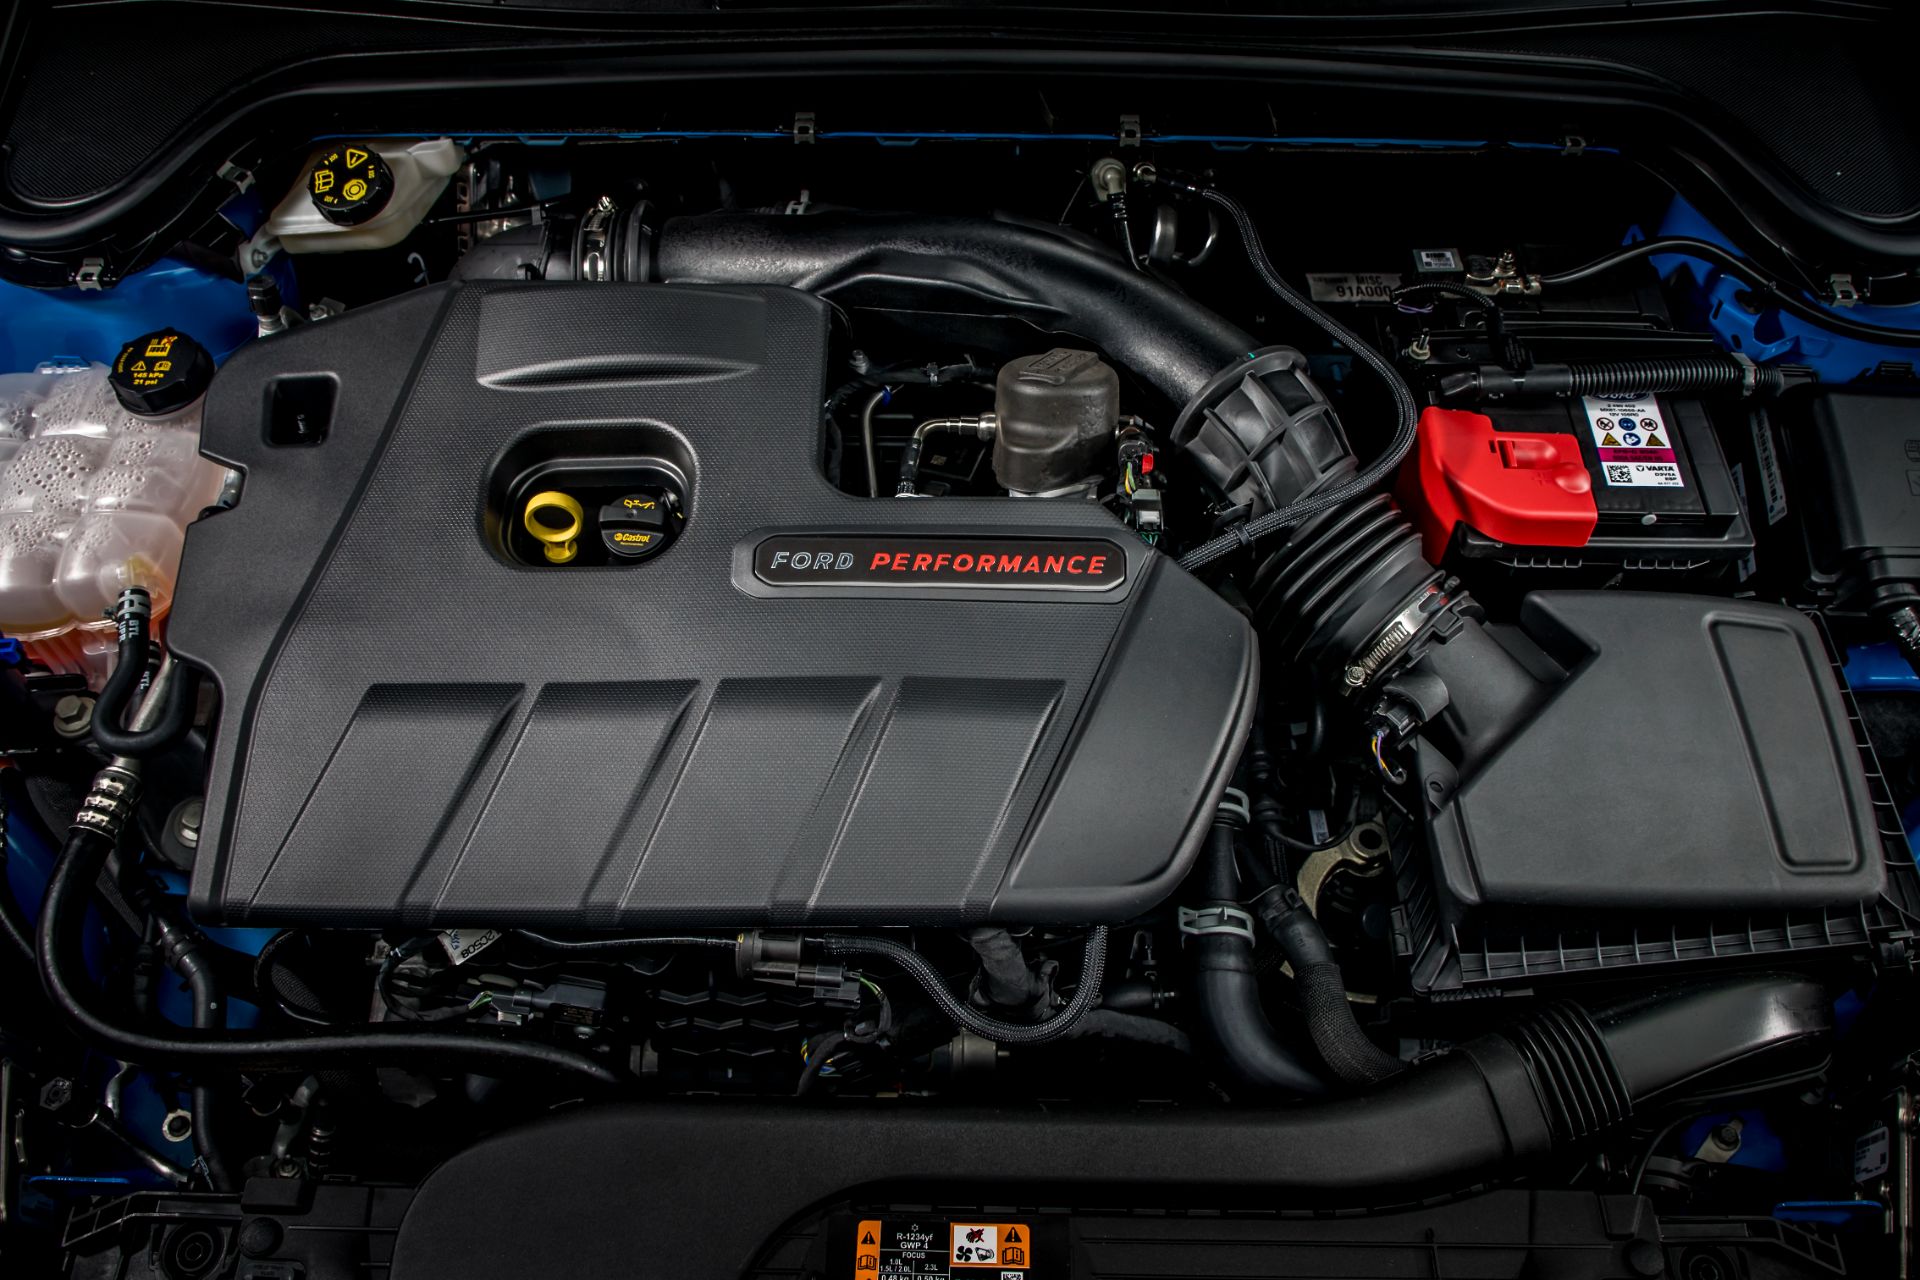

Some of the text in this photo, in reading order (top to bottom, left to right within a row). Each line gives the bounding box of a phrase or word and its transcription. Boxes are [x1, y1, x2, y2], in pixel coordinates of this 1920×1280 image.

[1356, 275, 1383, 286] MISC
[622, 533, 651, 543] Castrol
[771, 551, 1107, 575] FORD PERFORMANCE
[461, 929, 496, 959] 2C508
[896, 1232, 934, 1243] R-1234yf
[900, 1241, 929, 1250] GWP 4
[902, 1251, 926, 1259] FOCUS
[890, 1258, 903, 1266] 1.0L
[924, 1263, 938, 1271] 2.3L
